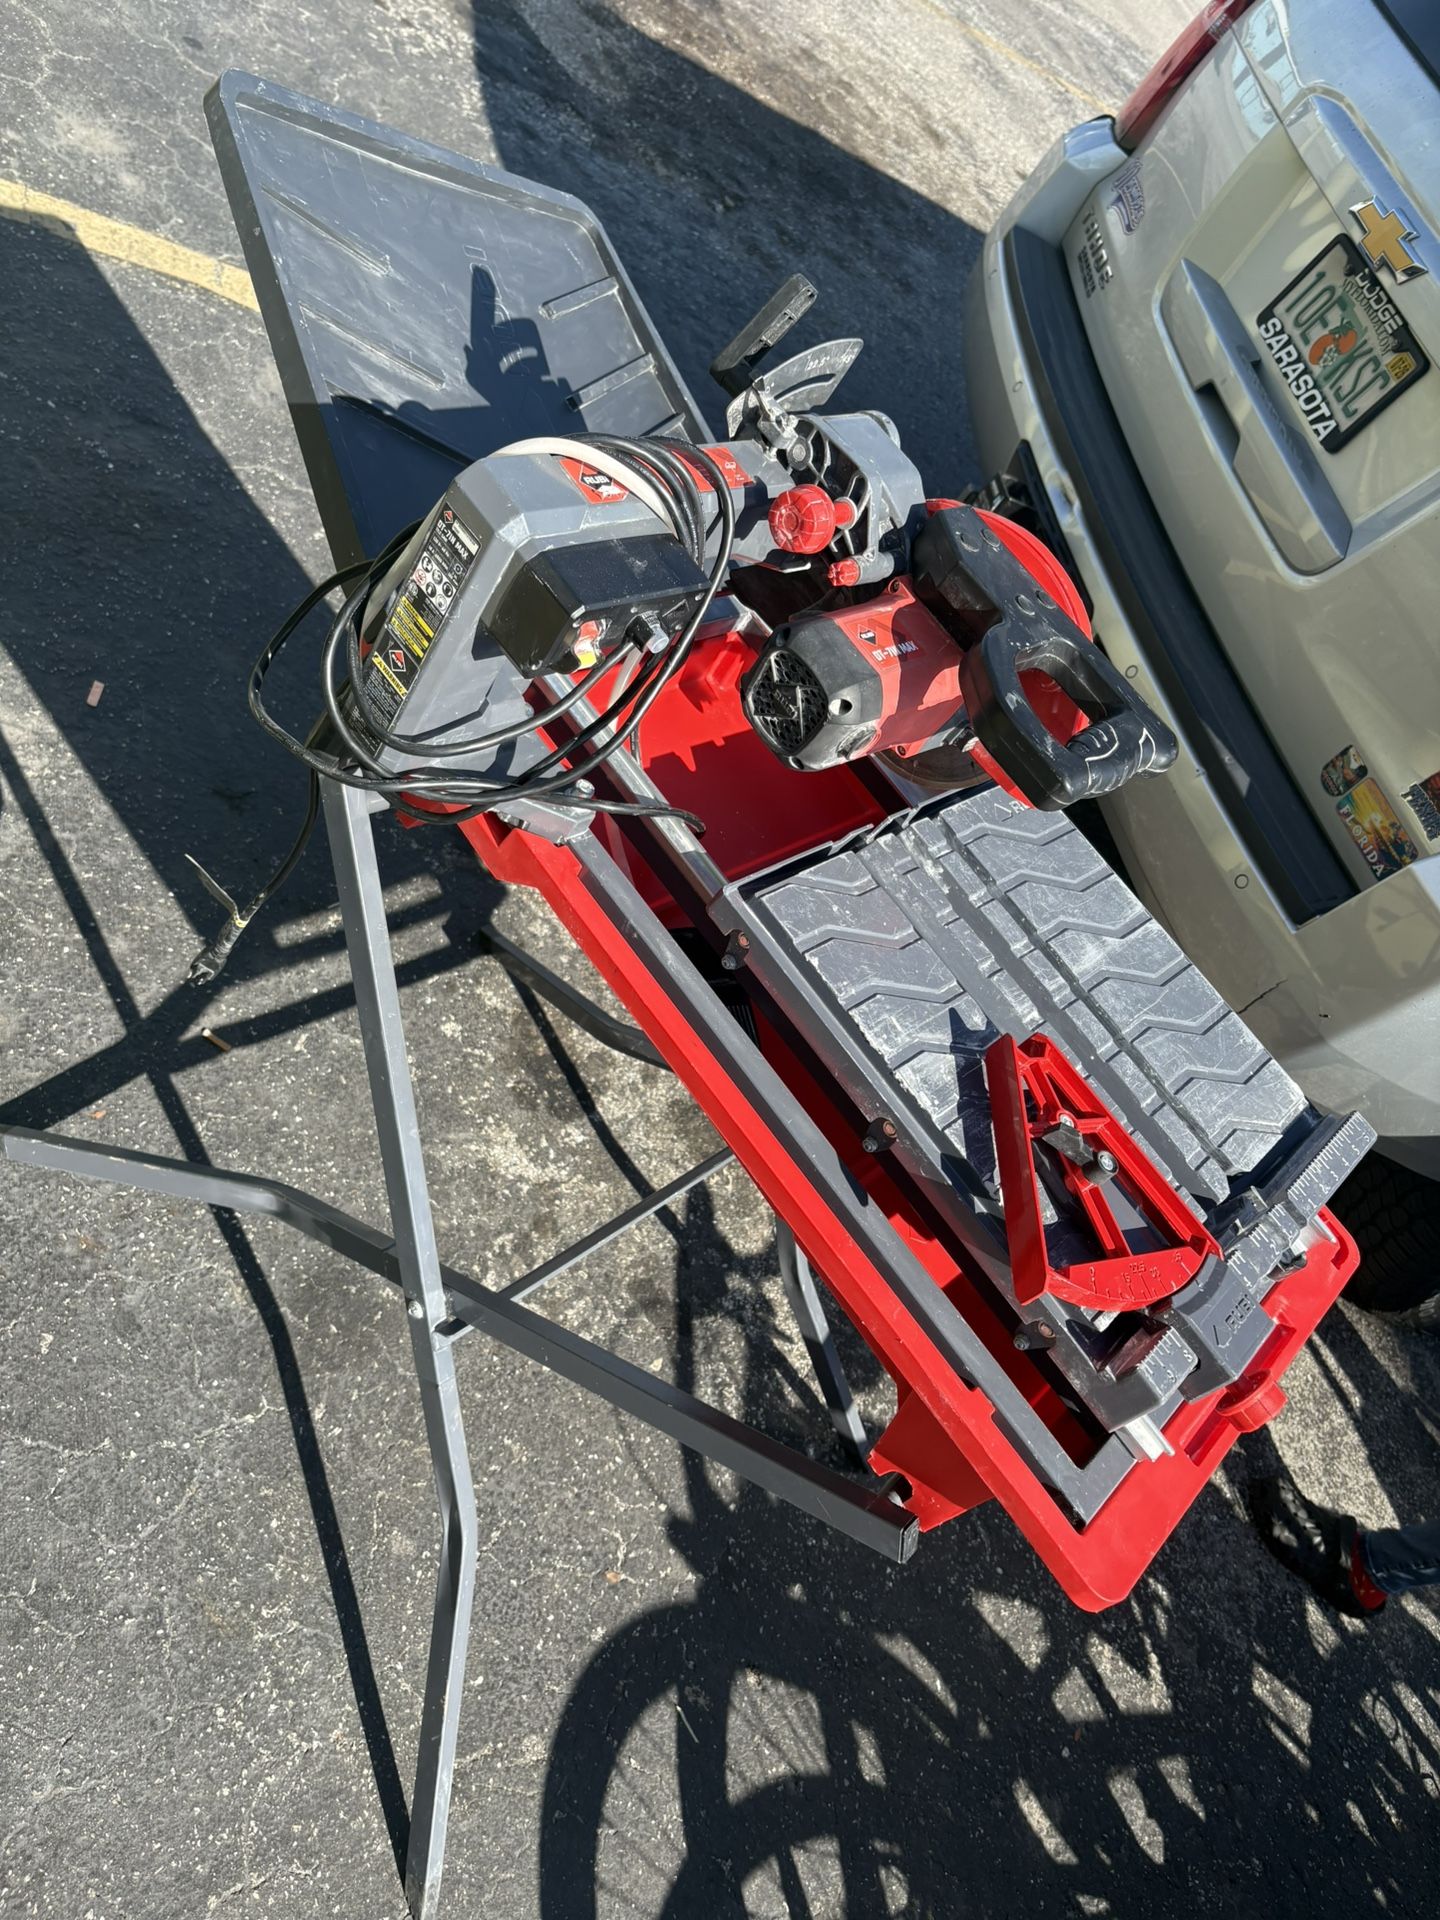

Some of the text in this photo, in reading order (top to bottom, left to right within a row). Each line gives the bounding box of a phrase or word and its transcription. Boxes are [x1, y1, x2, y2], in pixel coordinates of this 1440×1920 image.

[1353, 268, 1403, 334] DODGE
[1258, 315, 1337, 441] SARASOTA
[583, 476, 609, 484] RUBI
[383, 665, 403, 692] WARNING
[1338, 804, 1385, 877] FLORIDA
[1163, 1348, 1194, 1383] 9 8
